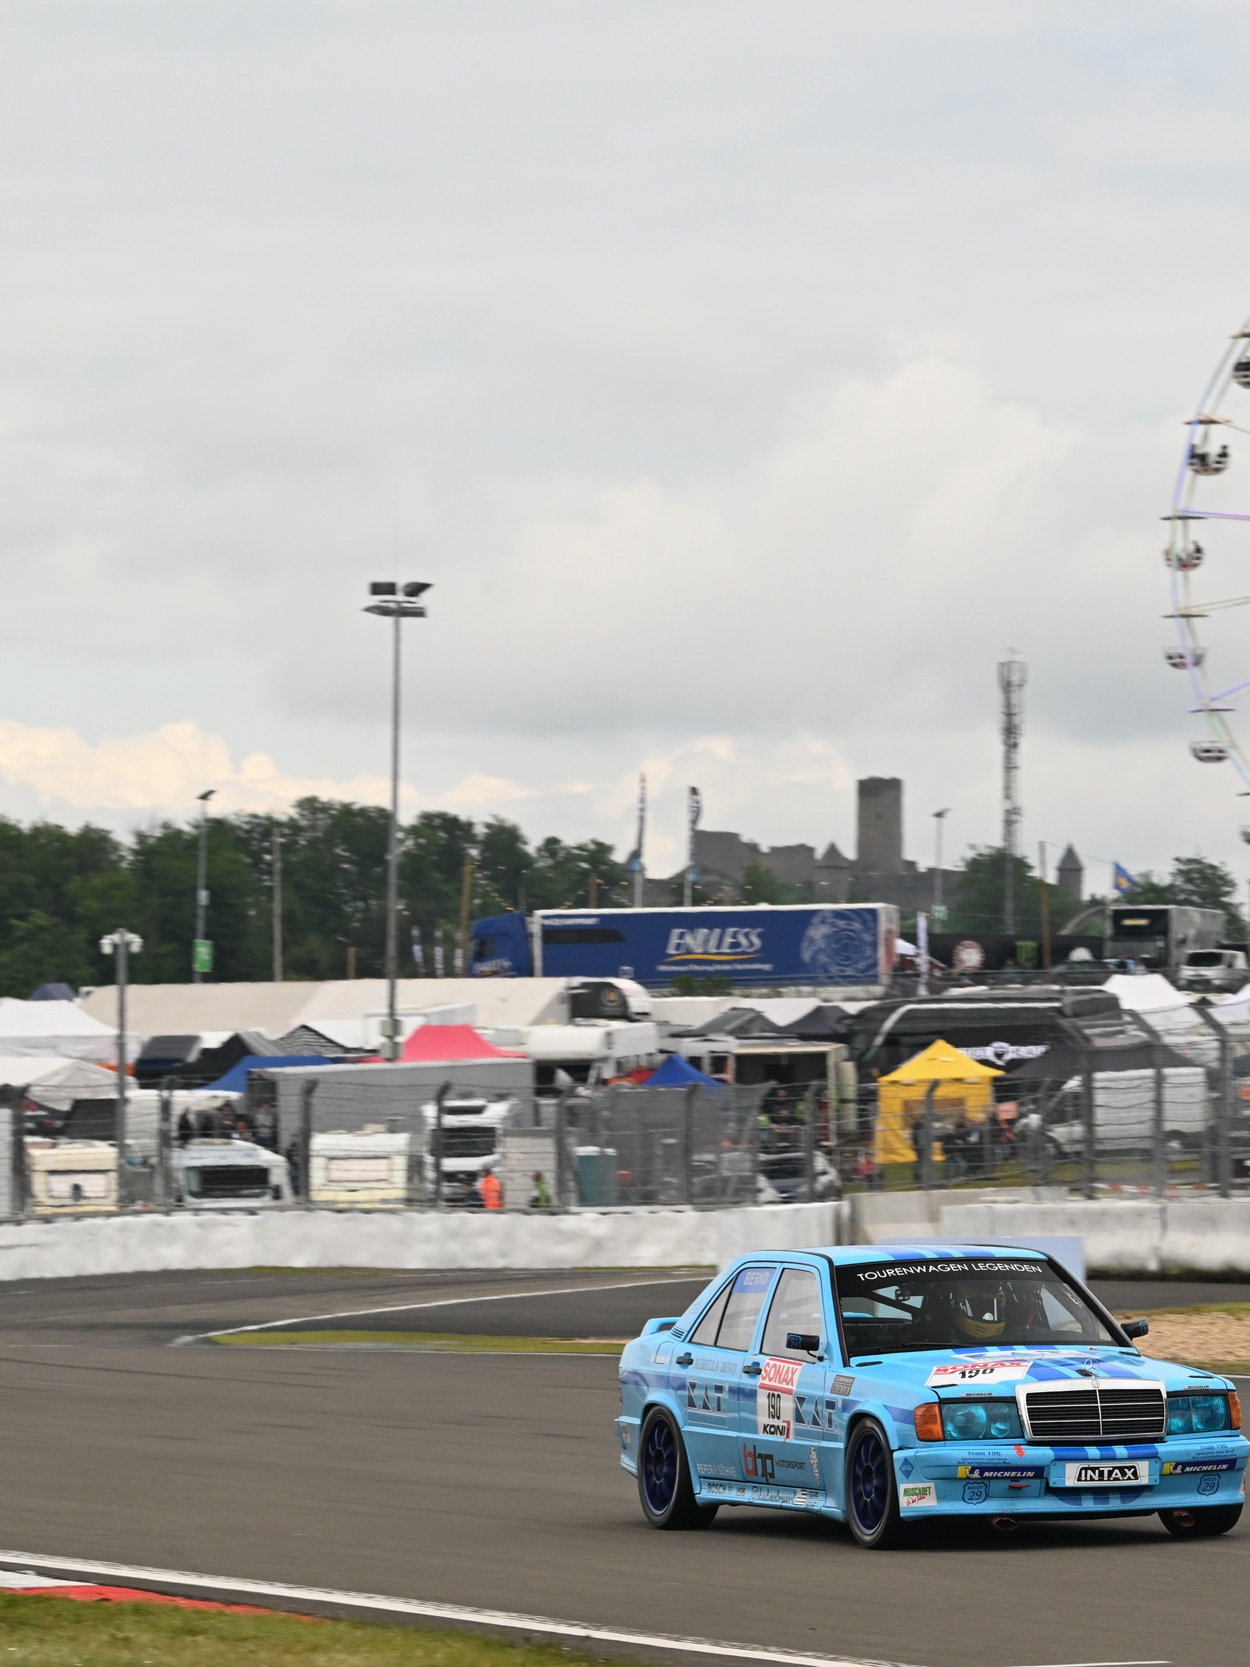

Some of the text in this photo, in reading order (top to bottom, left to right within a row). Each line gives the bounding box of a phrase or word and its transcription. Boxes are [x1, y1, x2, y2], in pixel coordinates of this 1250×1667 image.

[666, 928, 765, 954] ENDLESS
[857, 1262, 1042, 1282] TOURENWAGEN LEGENDEN
[761, 1362, 798, 1386] SONAX
[934, 1361, 1024, 1376] SONAX
[958, 1368, 995, 1379] 190
[767, 1392, 781, 1420] 190
[763, 1423, 786, 1436] KONI
[775, 1460, 805, 1470] MOTORSPORT
[1184, 1464, 1228, 1472] MICHELIN
[1081, 1467, 1136, 1481] INTAX
[708, 1483, 726, 1494] BOSCH
[903, 1486, 931, 1497] MUSCADET
[1201, 1482, 1215, 1492] 29
[967, 1490, 982, 1501] 29
